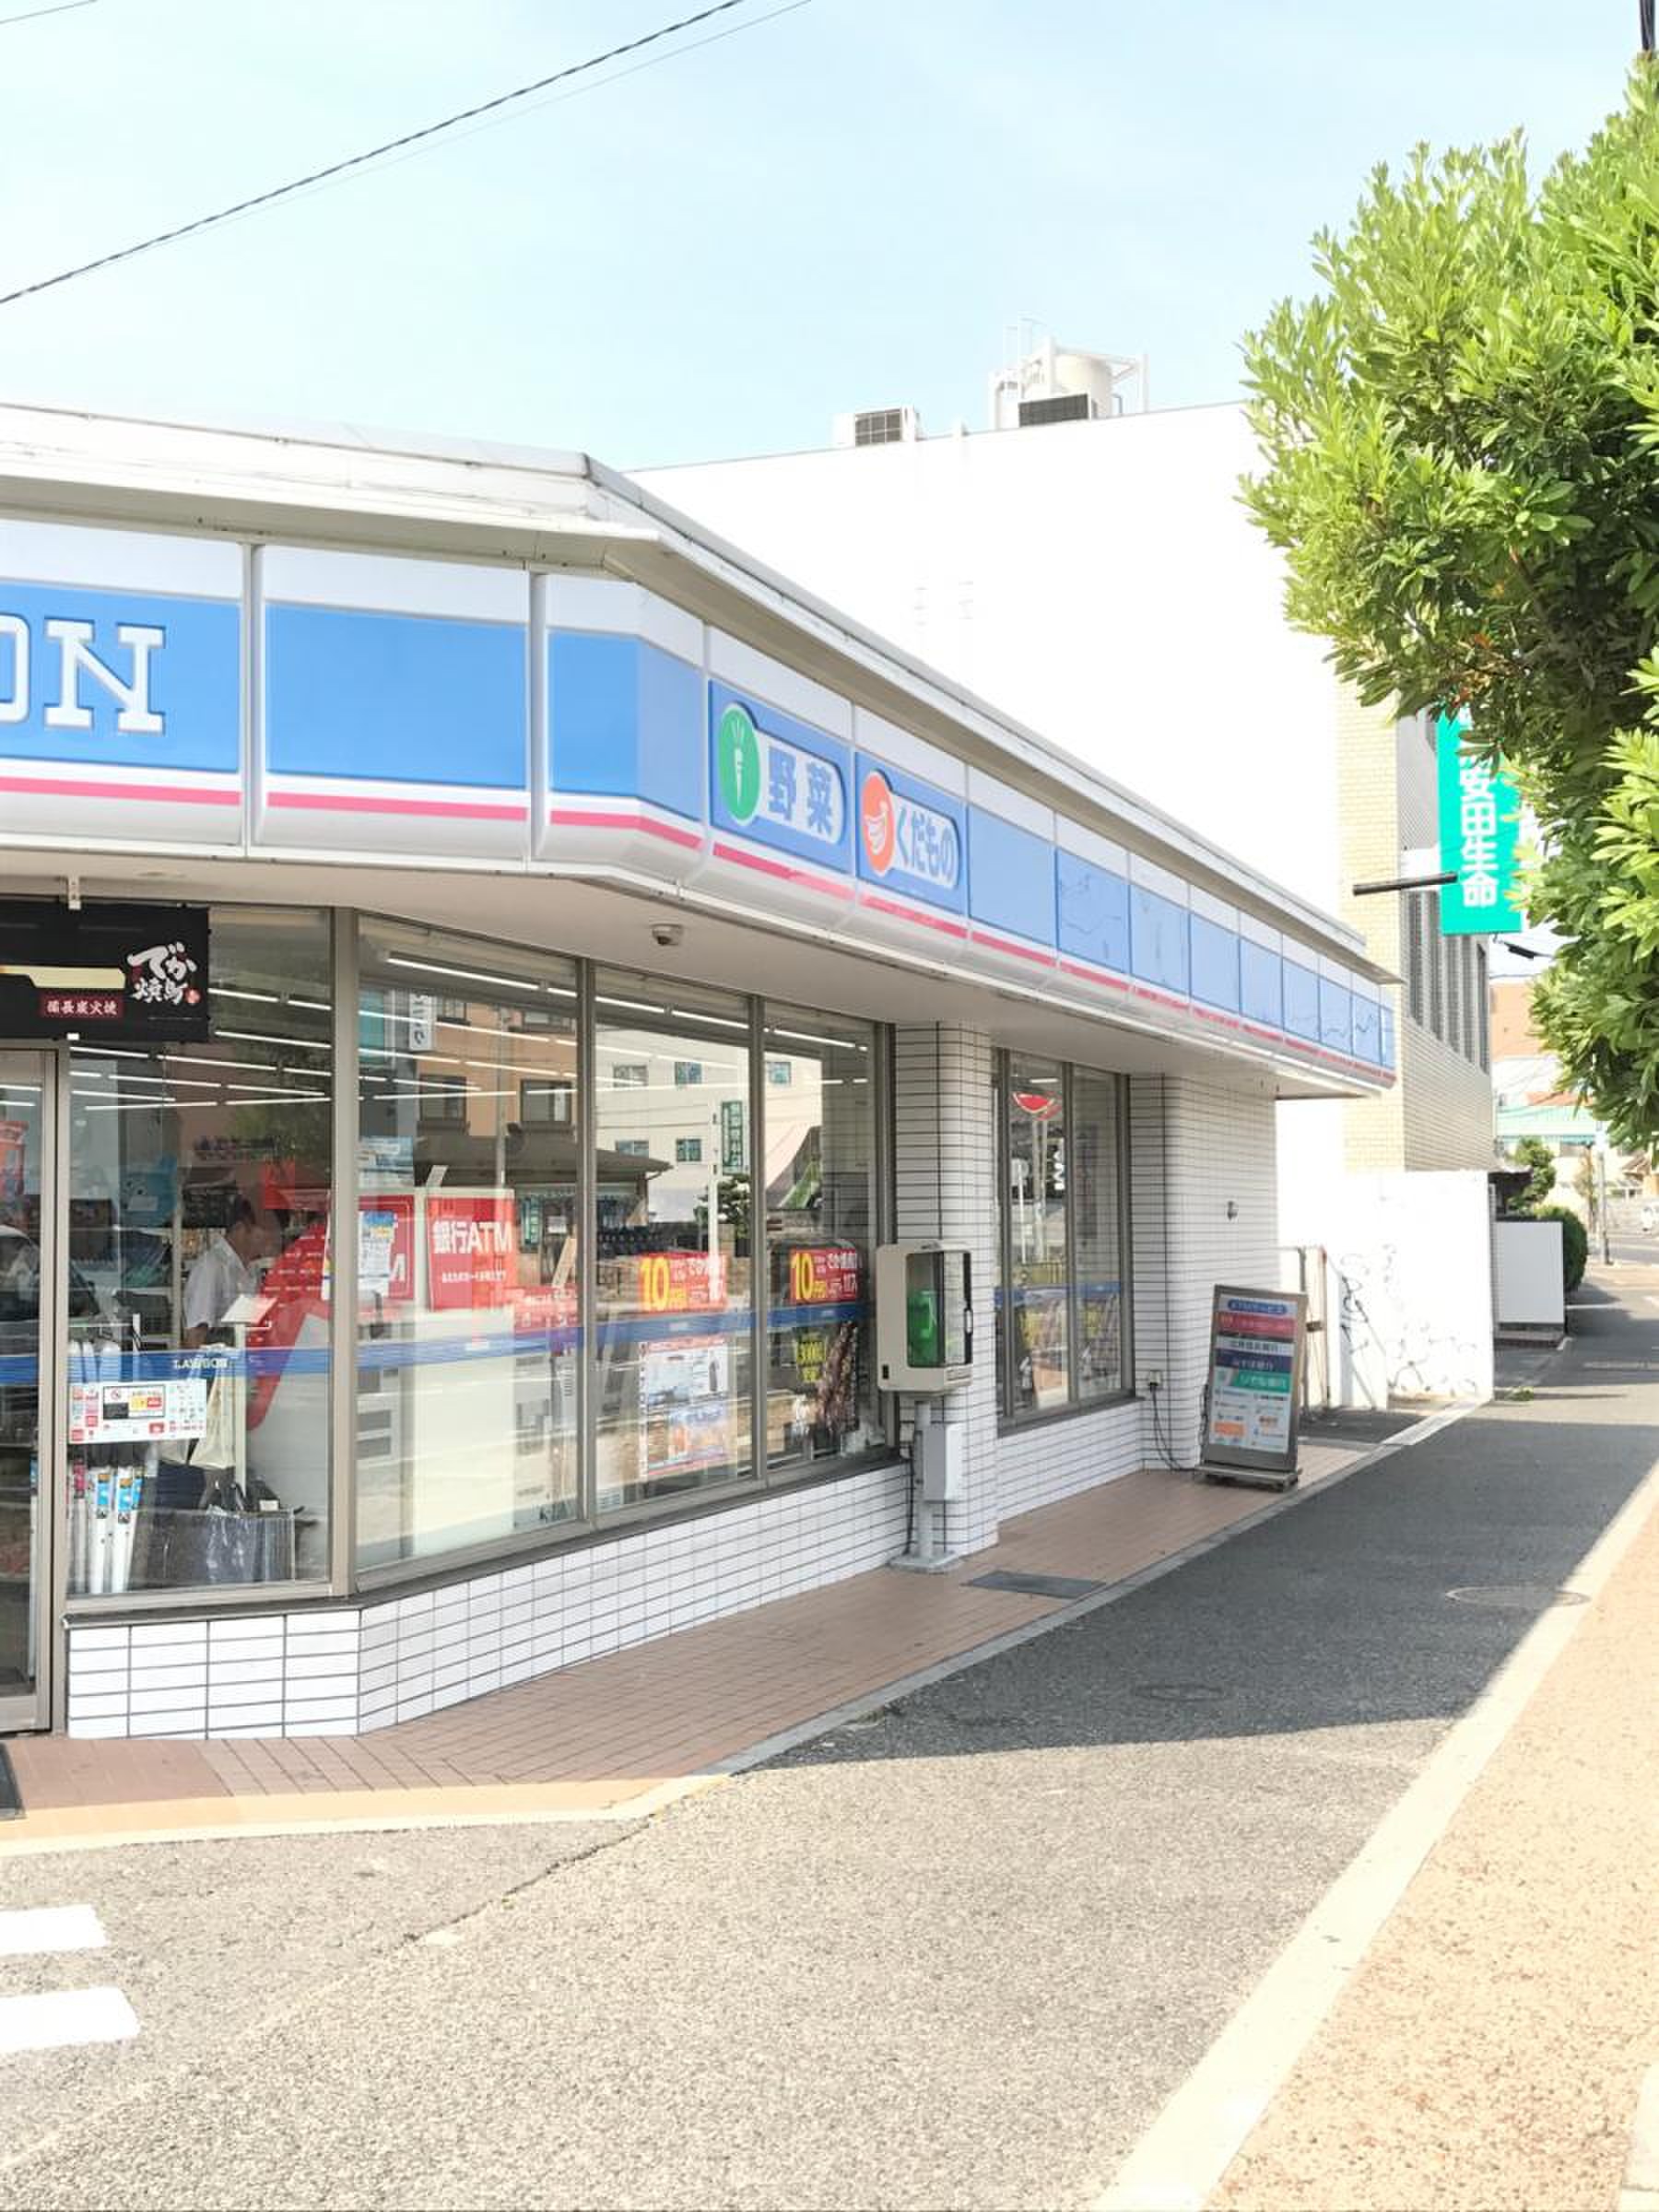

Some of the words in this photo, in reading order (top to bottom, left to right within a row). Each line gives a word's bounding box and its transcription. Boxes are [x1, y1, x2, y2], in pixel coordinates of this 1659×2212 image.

[768, 745, 834, 836] 野菜
[897, 805, 955, 883] くだもの
[640, 1255, 670, 1311] 10
[790, 1252, 814, 1300] 10
